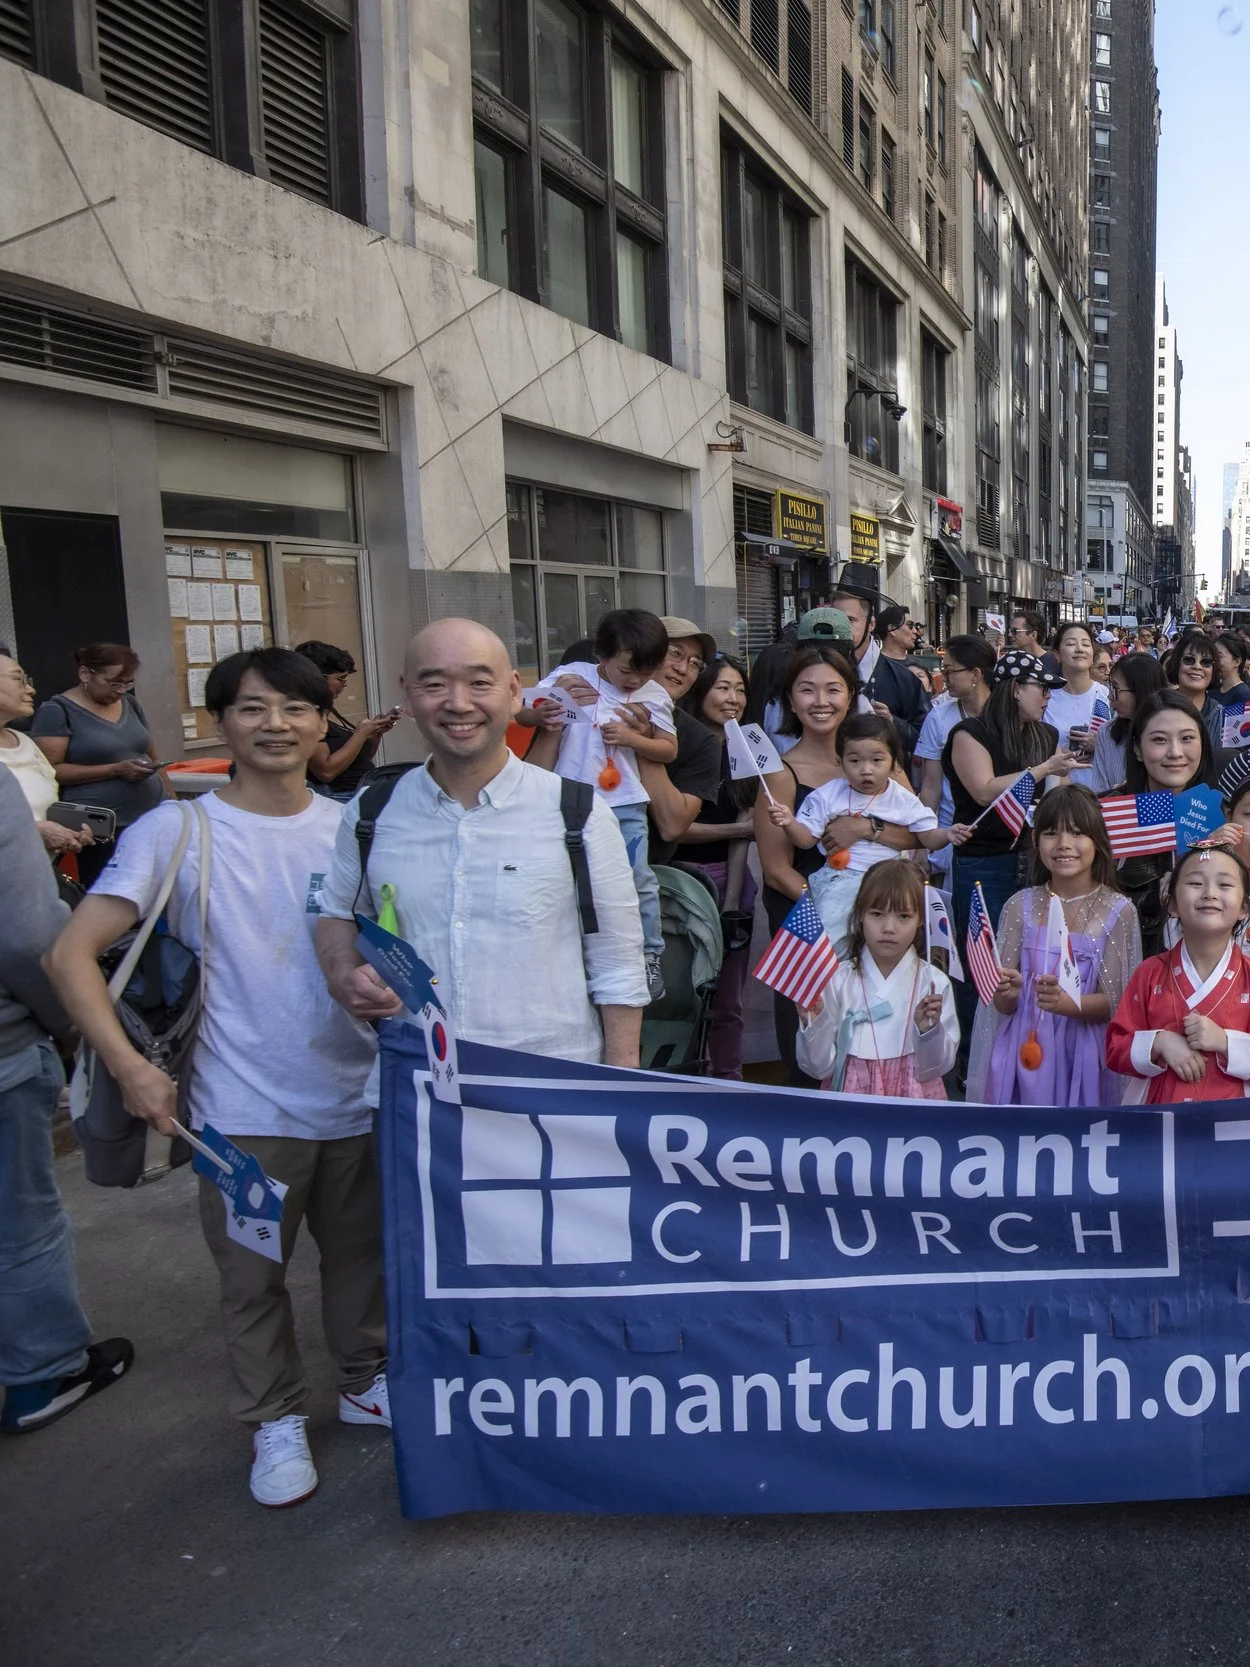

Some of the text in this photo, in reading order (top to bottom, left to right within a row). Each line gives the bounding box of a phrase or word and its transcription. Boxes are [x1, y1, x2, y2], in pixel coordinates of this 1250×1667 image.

[789, 499, 817, 520] PISILLO
[852, 519, 874, 535] PISILLO
[1191, 798, 1208, 811] Who
[1187, 809, 1207, 821] Jesus
[1180, 816, 1210, 833] Died For
[648, 1115, 1121, 1199] Remnant
[651, 1200, 1124, 1263] CHURCH
